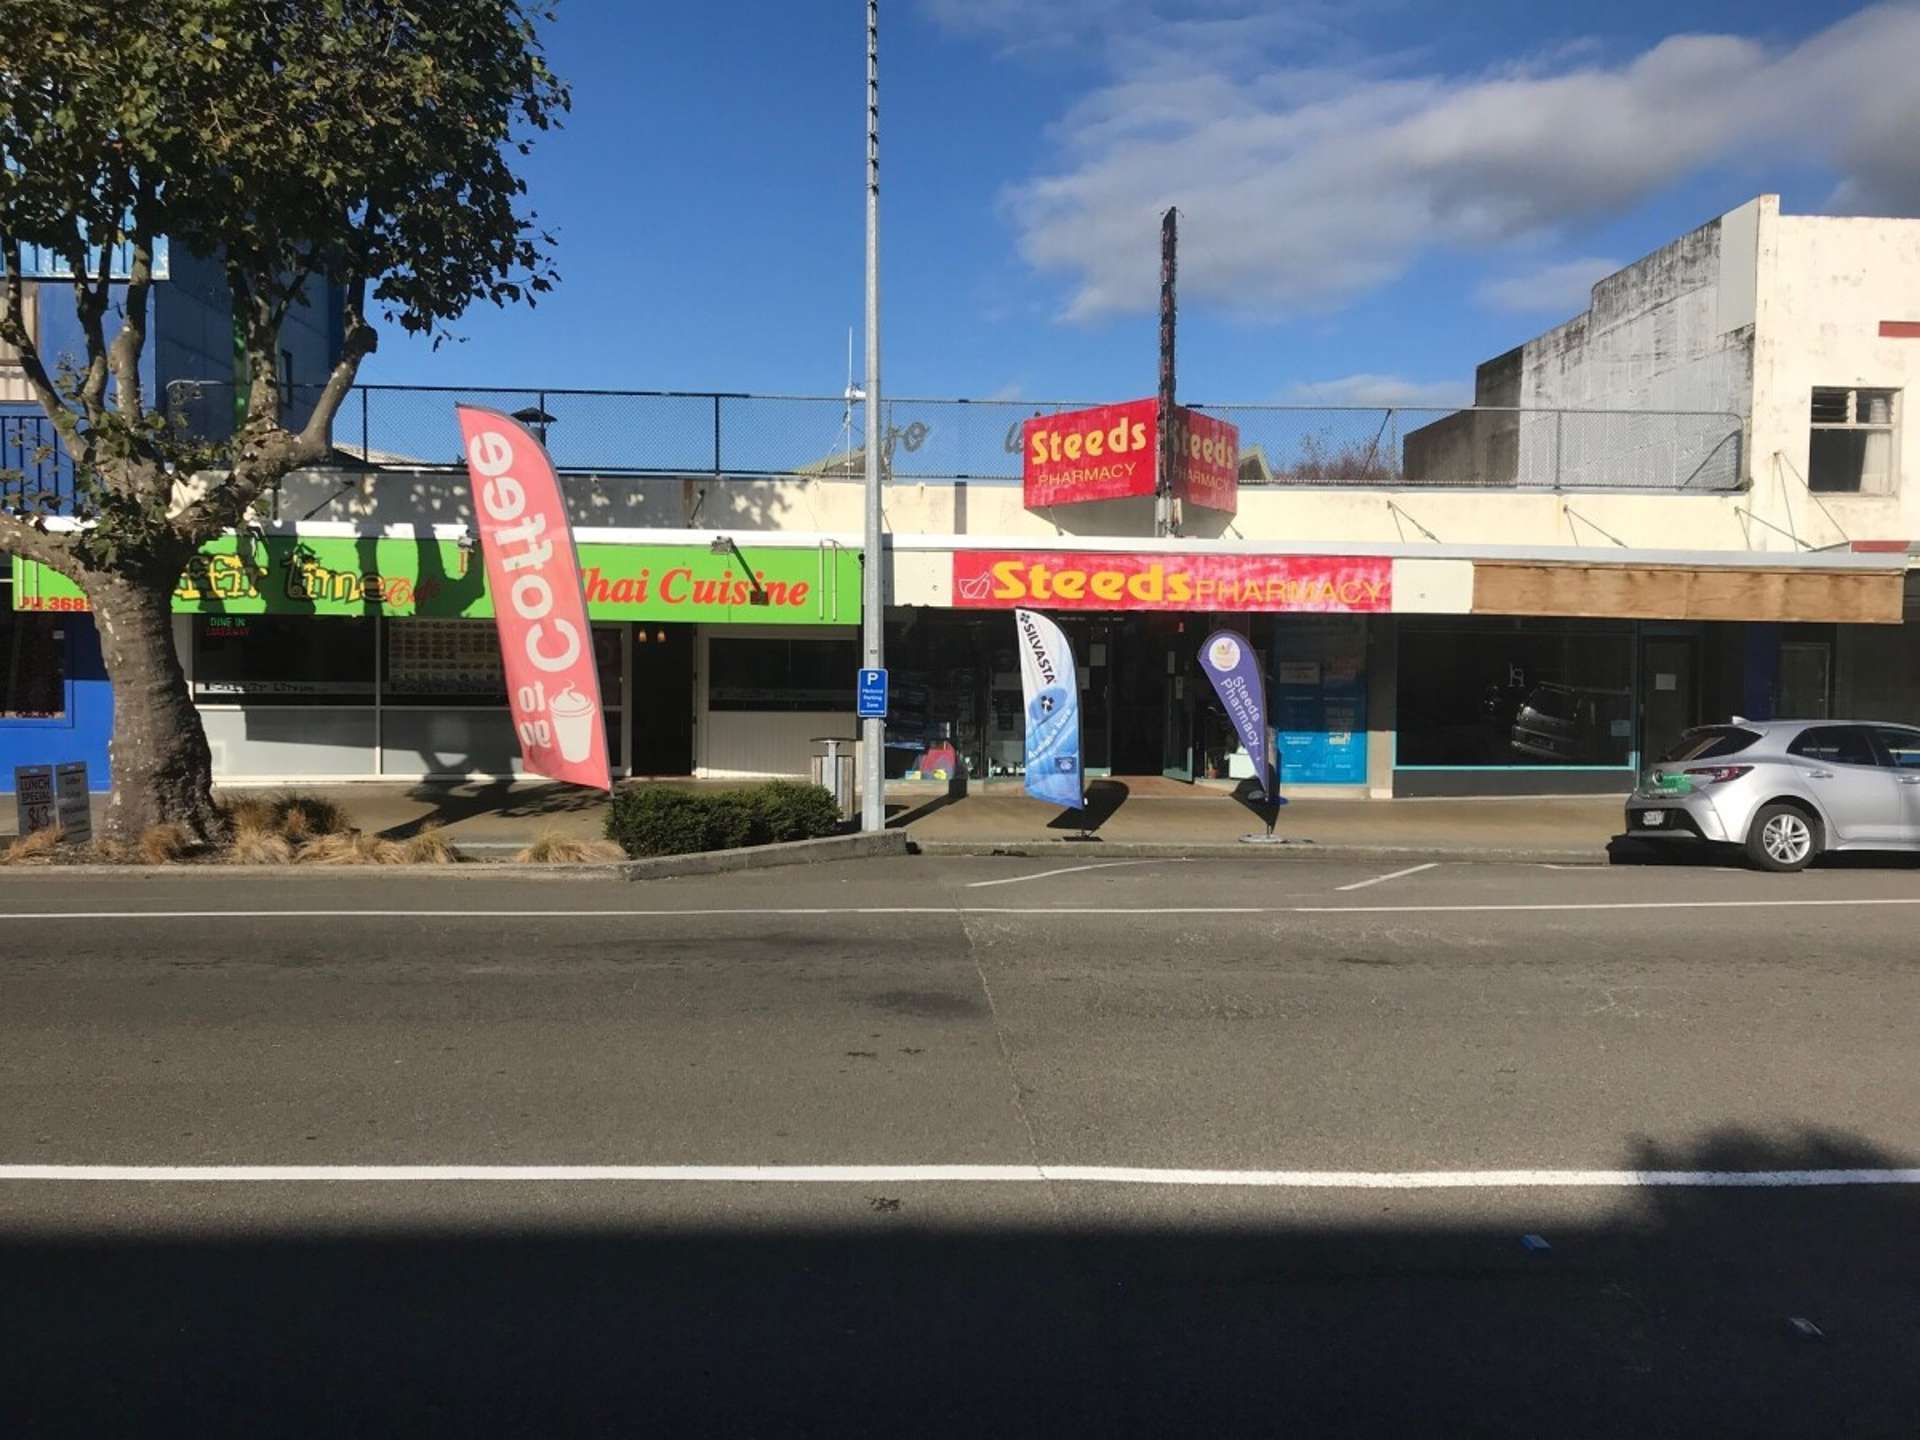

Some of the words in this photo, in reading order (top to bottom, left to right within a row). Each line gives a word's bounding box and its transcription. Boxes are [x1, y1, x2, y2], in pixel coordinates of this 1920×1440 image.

[1031, 417, 1147, 465] Steeds
[1037, 462, 1137, 486] PHARMACY
[577, 567, 649, 604] hai
[991, 560, 1193, 602] Steeds
[1194, 579, 1385, 605] PHARMACY
[1023, 623, 1056, 685] SILVASTA
[867, 672, 879, 686] P
[1233, 676, 1260, 722] Steeds
[1220, 678, 1260, 747] Pharmacy
[20, 778, 50, 791] LUNCH
